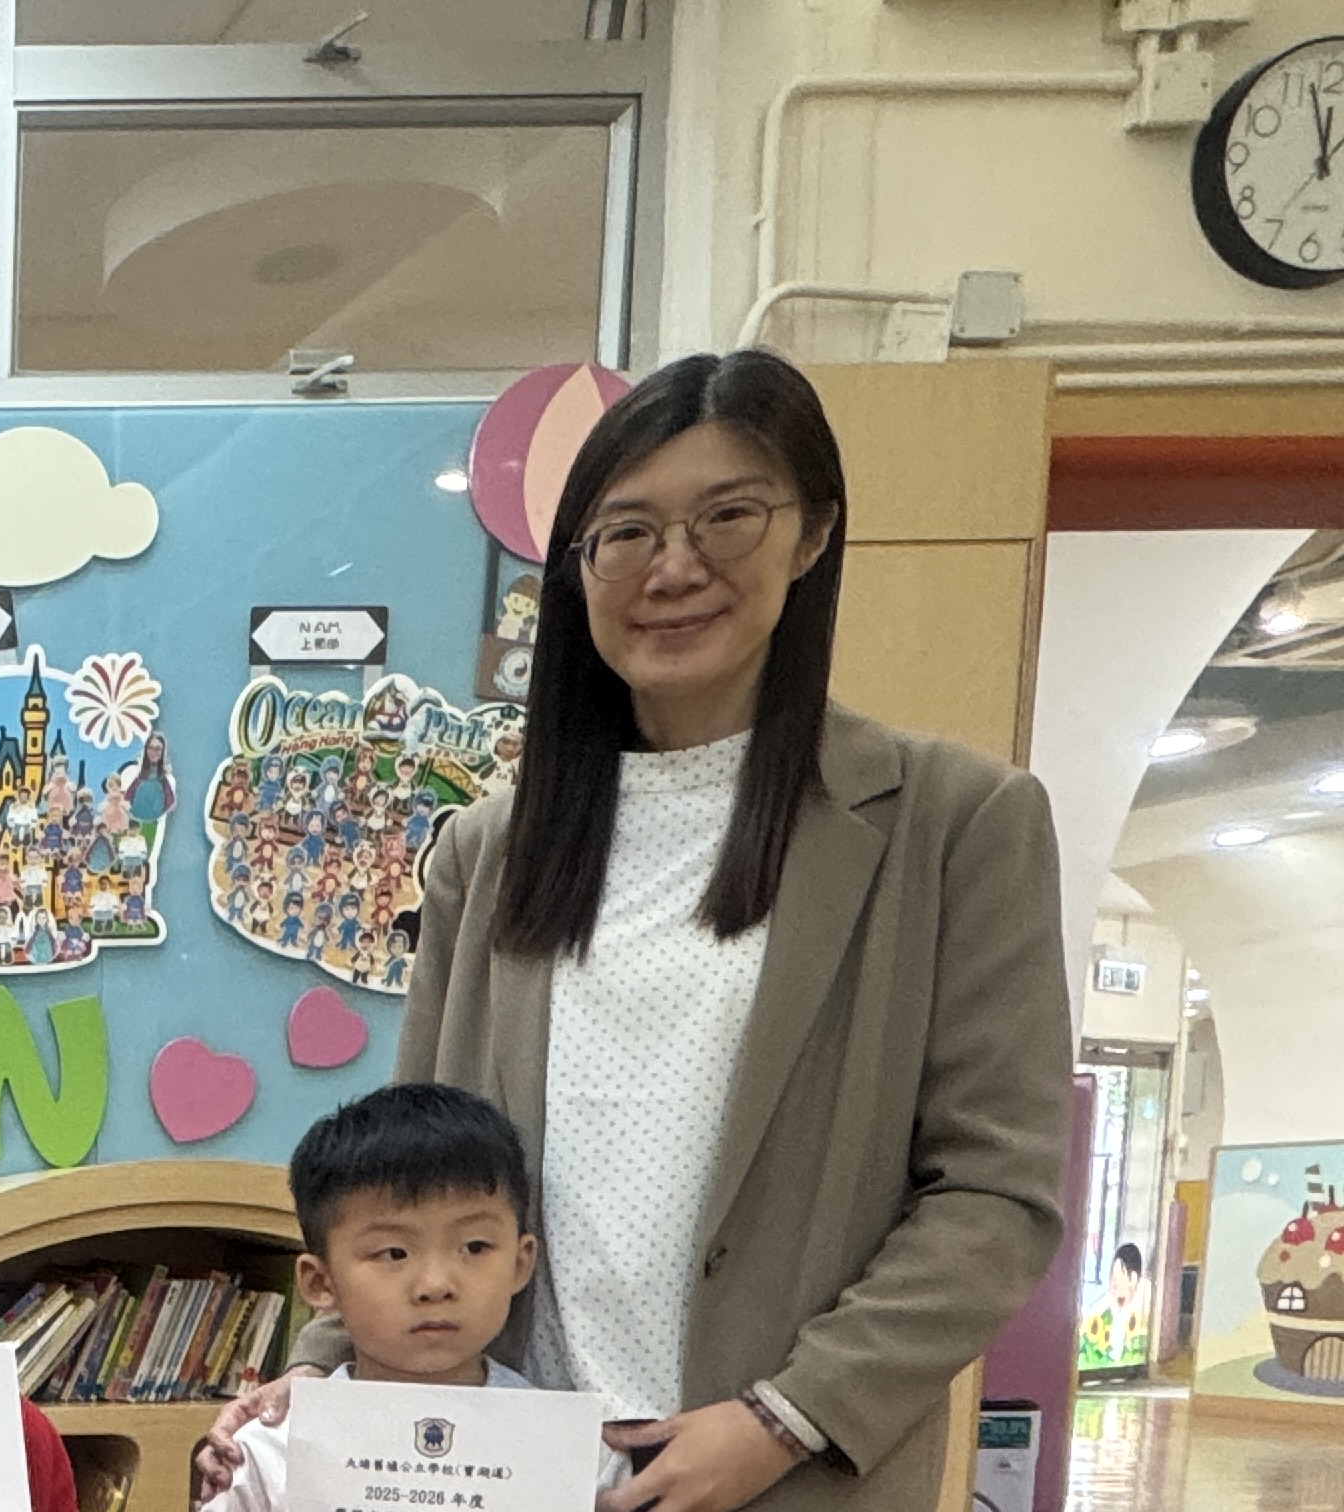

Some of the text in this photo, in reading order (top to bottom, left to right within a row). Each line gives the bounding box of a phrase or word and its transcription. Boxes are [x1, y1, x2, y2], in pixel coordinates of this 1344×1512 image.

[1283, 72, 1304, 107] 11
[1247, 105, 1281, 137] 10
[1229, 142, 1249, 175] 9
[1236, 186, 1255, 219] 8
[1266, 219, 1283, 249] 7
[1299, 232, 1320, 263] 6
[237, 681, 364, 757] Ocean
[280, 733, 354, 754] Hong Kong
[451, 1492, 485, 1509] 年度
